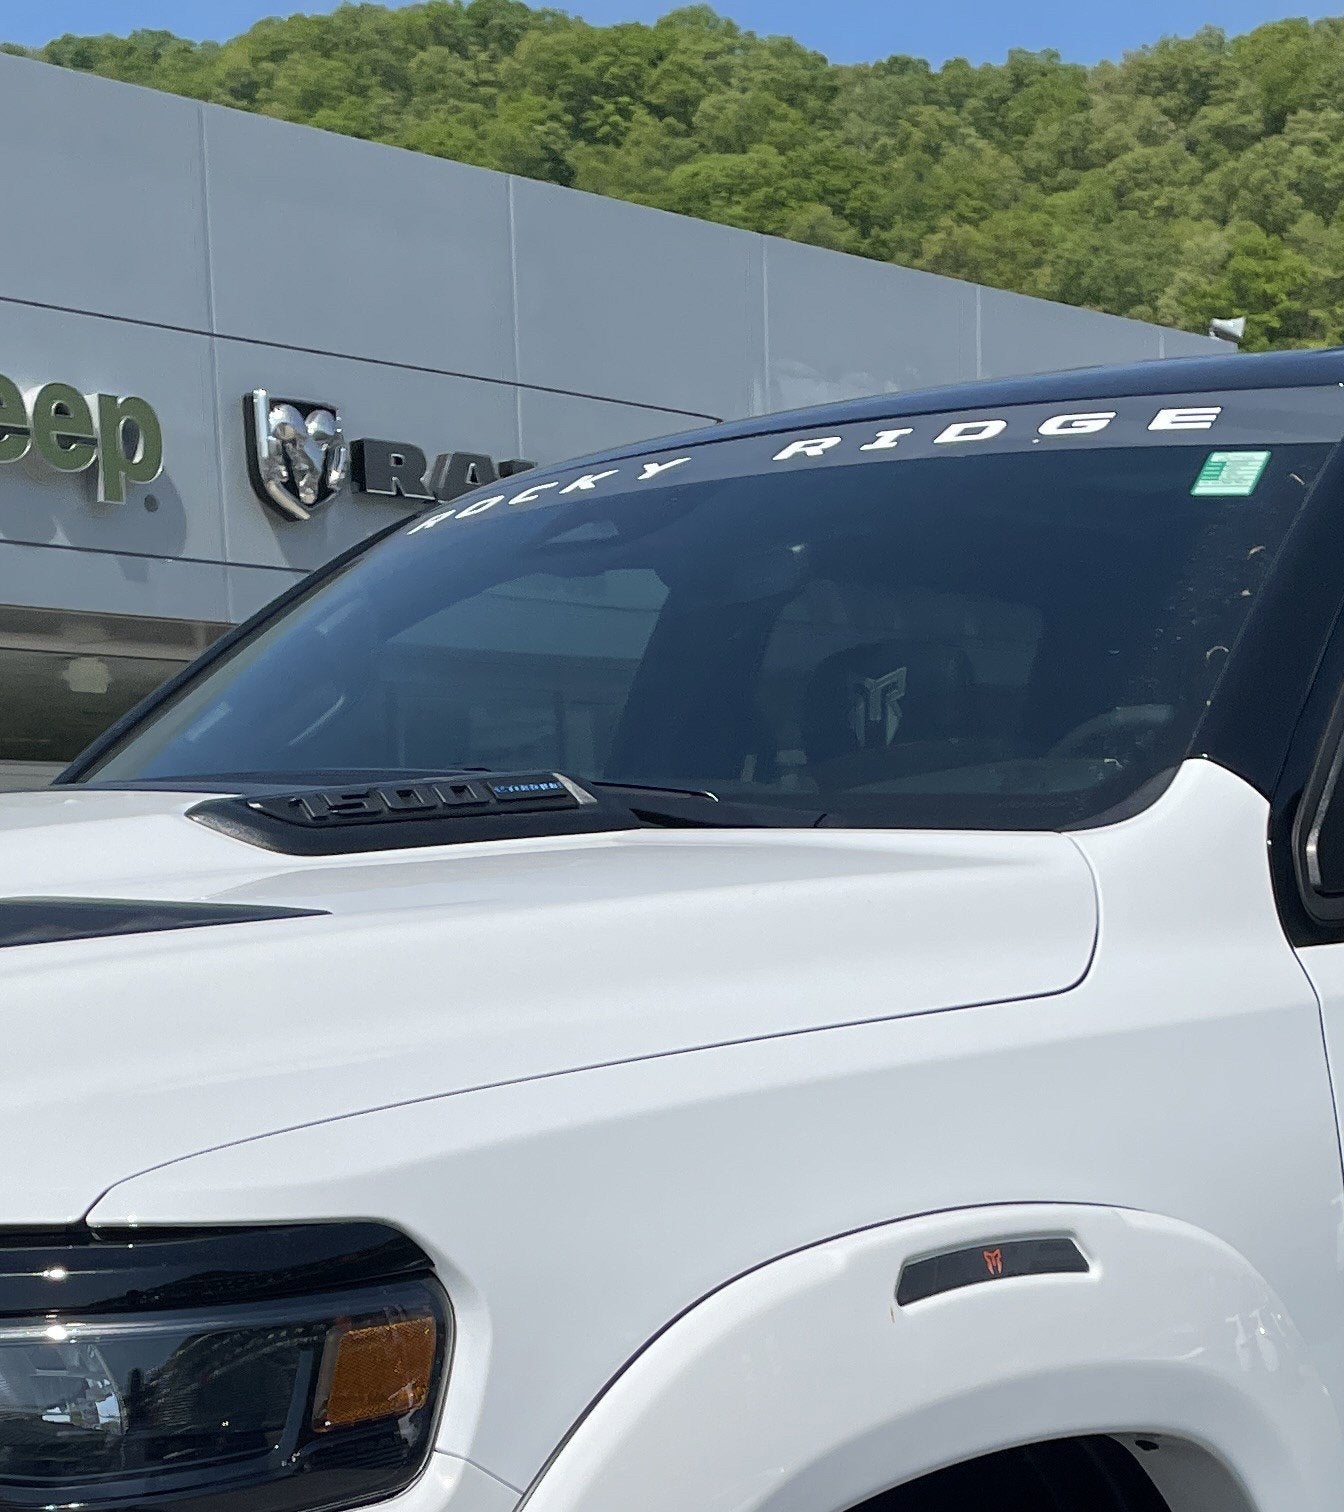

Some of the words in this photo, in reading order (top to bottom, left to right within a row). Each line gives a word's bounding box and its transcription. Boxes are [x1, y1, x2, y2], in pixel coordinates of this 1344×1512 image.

[350, 437, 536, 504] RA
[406, 456, 692, 536] ROCKY
[772, 405, 1223, 462] RIDGE
